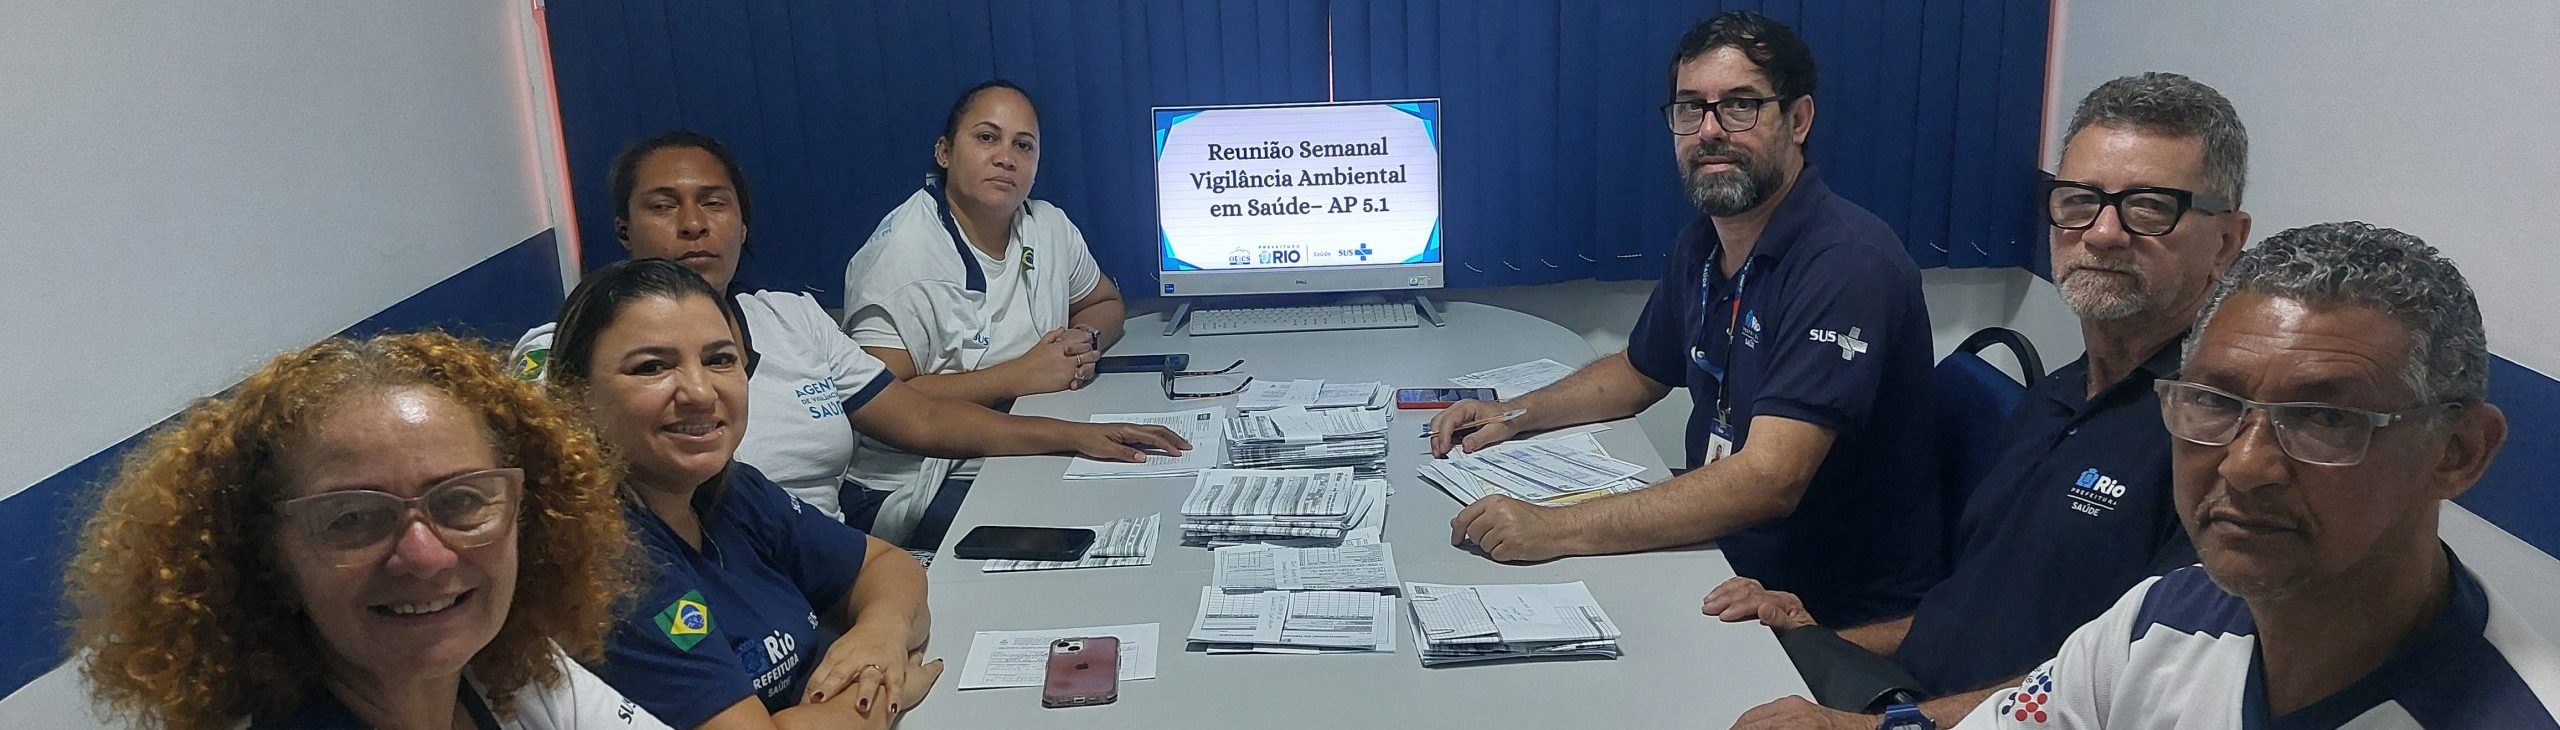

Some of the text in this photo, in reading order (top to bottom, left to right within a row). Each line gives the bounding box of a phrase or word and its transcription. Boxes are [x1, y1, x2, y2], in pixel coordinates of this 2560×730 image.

[1207, 136, 1389, 161] Reunião Semanal
[1189, 164, 1407, 194] Vigilância Ambiental
[1210, 204, 1243, 217] em
[1327, 196, 1358, 213] AP
[1362, 197, 1390, 213] 5.1
[1273, 250, 1301, 264] RIO
[1338, 249, 1353, 257] SUS
[1809, 329, 1836, 342] SUS
[795, 376, 836, 397] AGENT
[2070, 487, 2118, 506] PREFEITURA
[2093, 475, 2126, 498] Rio
[2071, 501, 2101, 517] SAÚDE
[763, 630, 795, 664] Rio
